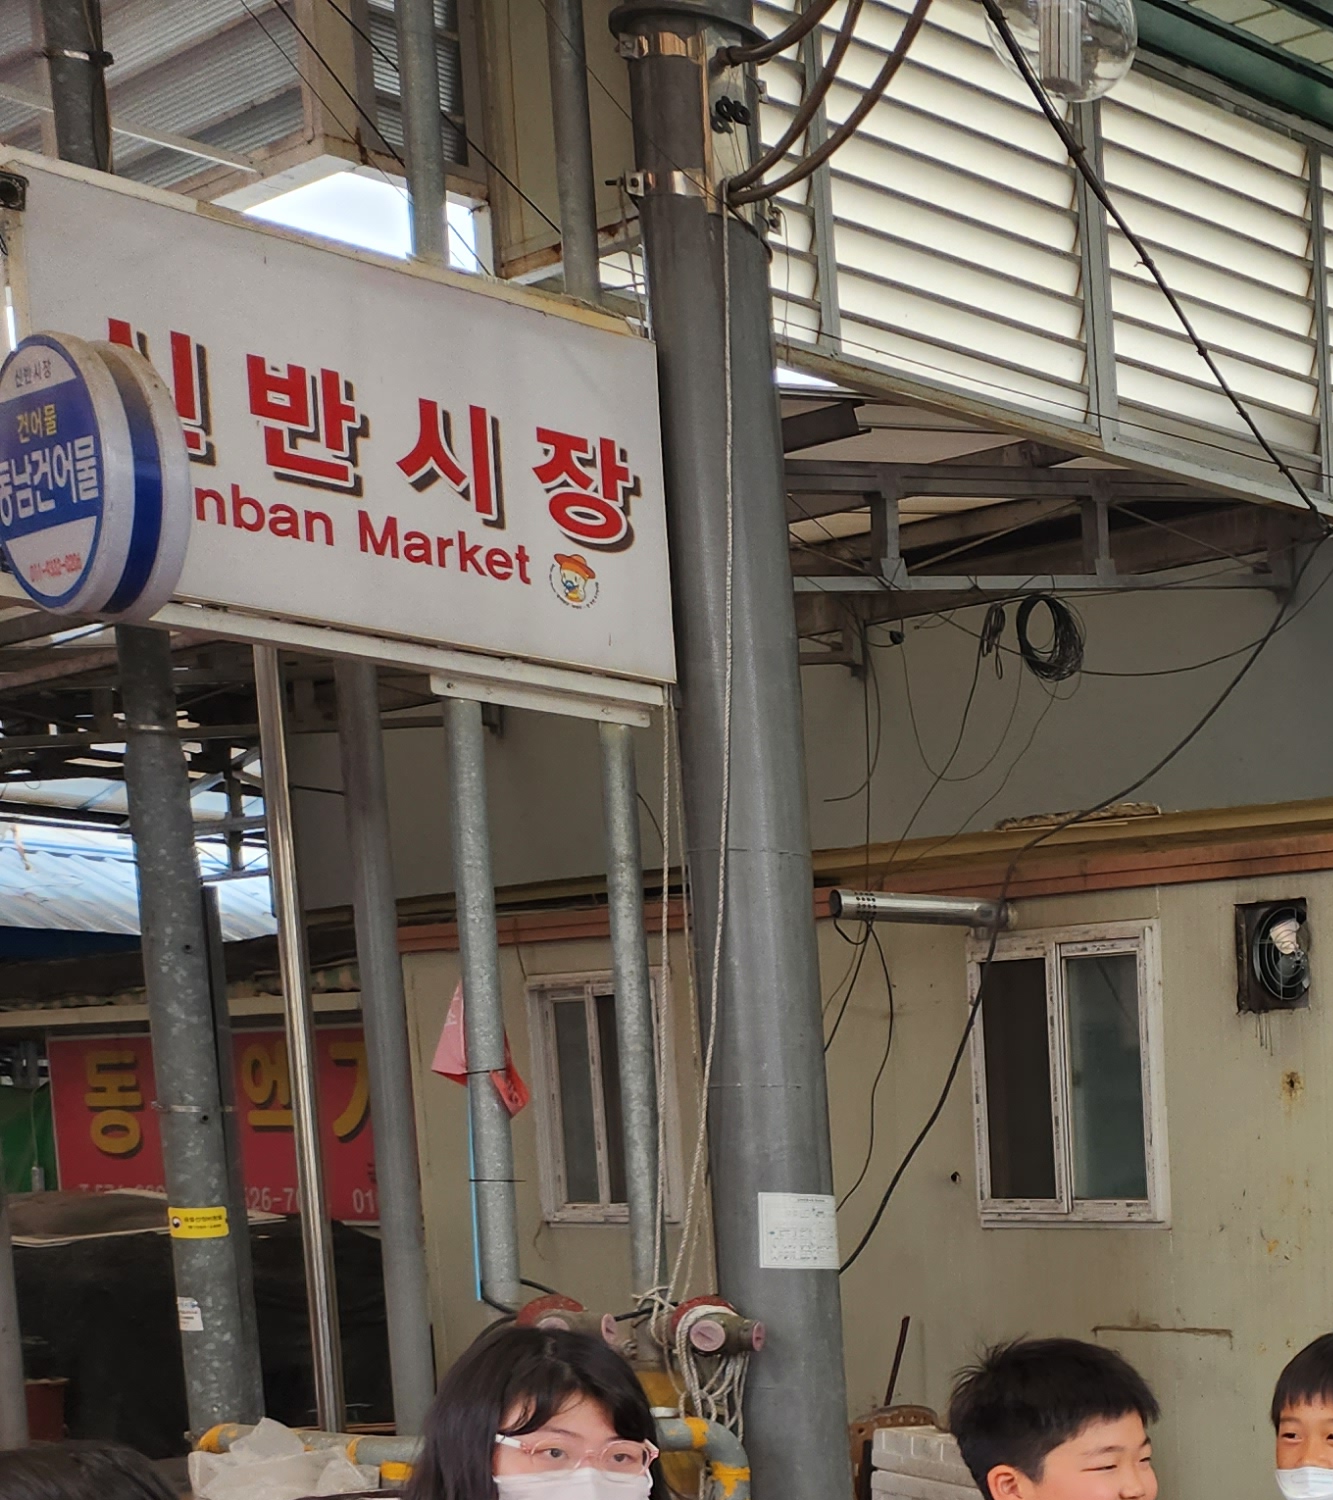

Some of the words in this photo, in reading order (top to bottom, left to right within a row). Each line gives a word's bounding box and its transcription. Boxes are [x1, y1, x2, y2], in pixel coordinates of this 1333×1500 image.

[14, 360, 51, 387] 신반시장
[17, 404, 58, 443] 건어물
[194, 483, 335, 546] nban
[358, 509, 532, 586] Market
